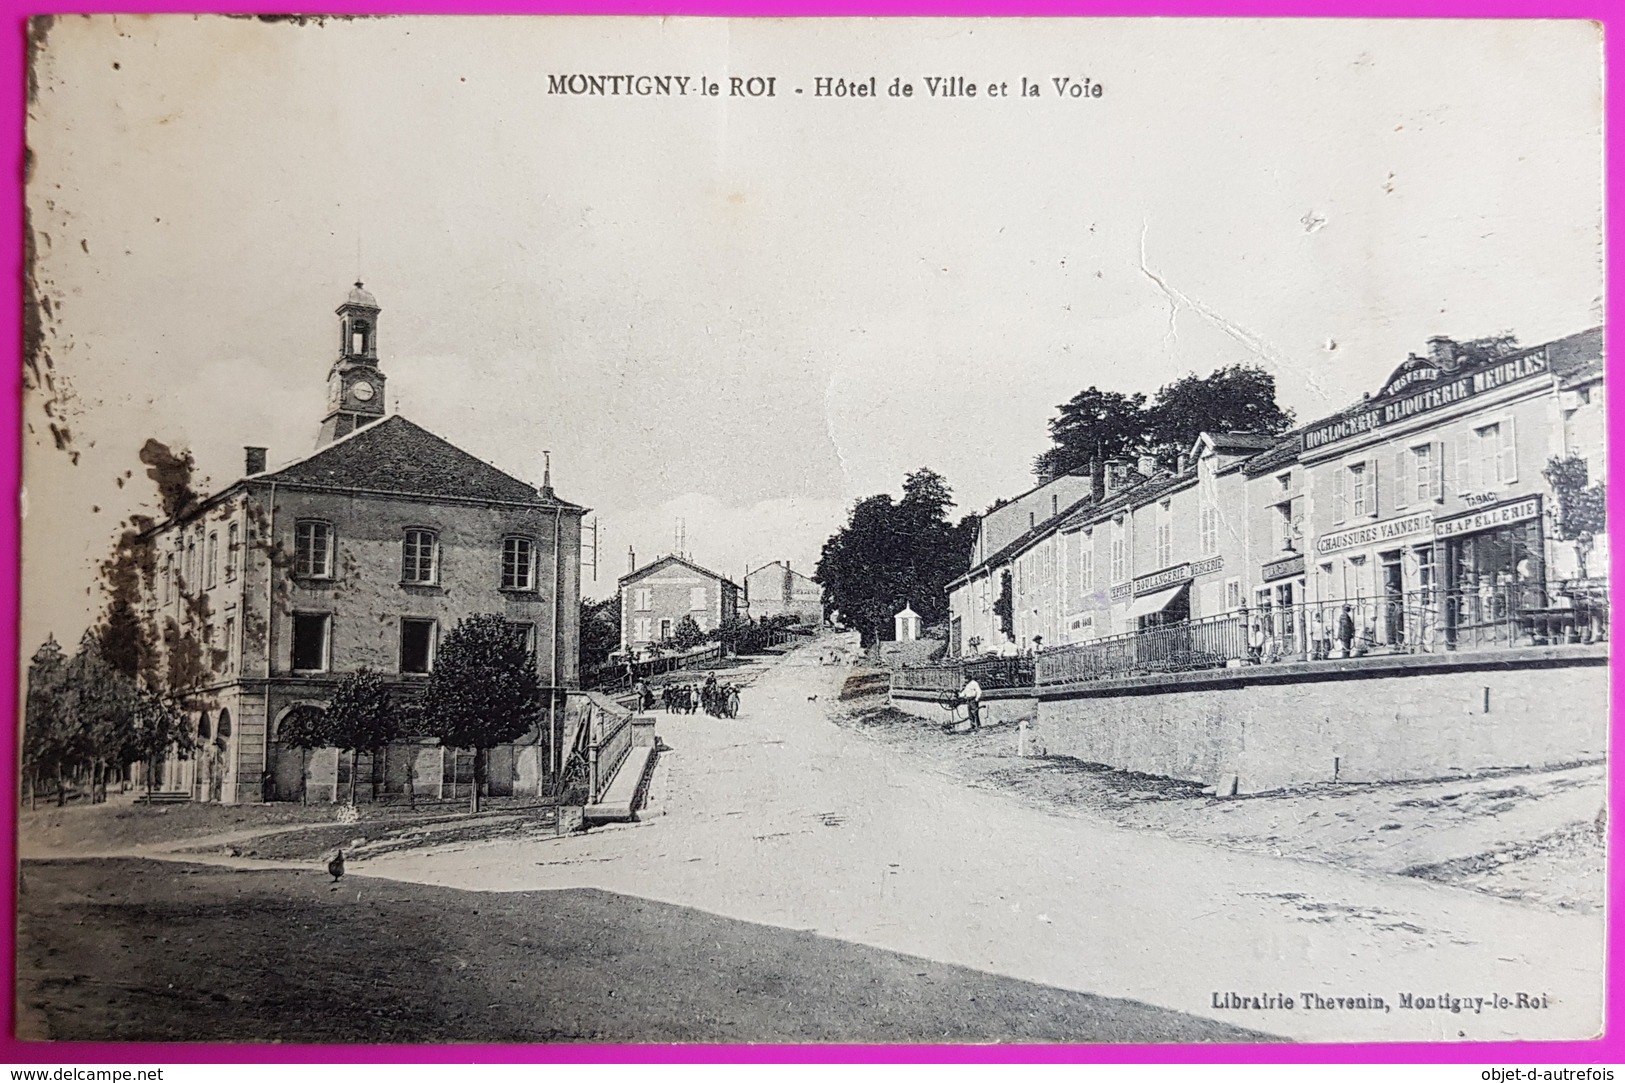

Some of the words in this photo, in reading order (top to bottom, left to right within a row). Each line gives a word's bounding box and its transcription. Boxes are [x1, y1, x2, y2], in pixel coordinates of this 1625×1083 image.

[1385, 379, 1468, 424] BIJOUTERIE
[1473, 351, 1547, 393] MEUBLES
[1320, 525, 1378, 551] CHAUSSURES
[1380, 515, 1432, 538] VANNERIE
[1436, 501, 1535, 536] CHAPELLERIE
[1135, 567, 1186, 591] BOULANGERIE
